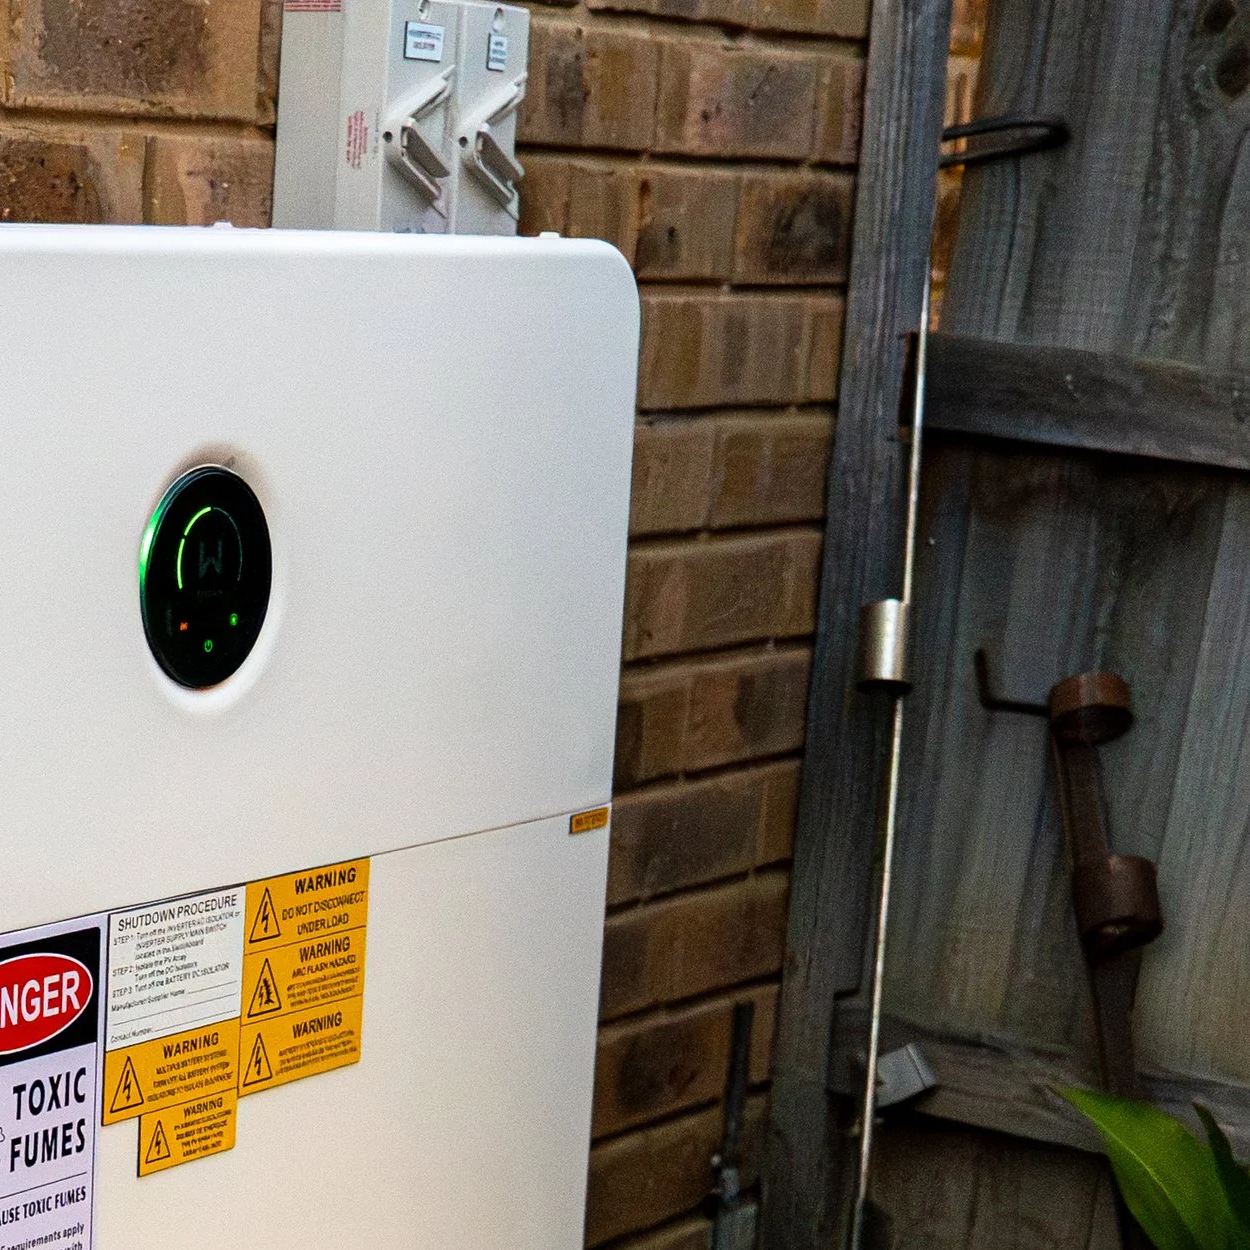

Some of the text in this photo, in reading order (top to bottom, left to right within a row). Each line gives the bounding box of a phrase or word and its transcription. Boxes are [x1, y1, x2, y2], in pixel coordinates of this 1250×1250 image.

[295, 868, 356, 895] WARNING
[118, 894, 238, 932] SHUTDOWN PROCEDURE
[282, 890, 365, 920] DO NOT DISCONNECT
[298, 913, 349, 935] UNDER LOAD
[113, 934, 130, 946] STEP
[300, 936, 350, 962] WARNING
[292, 1011, 342, 1038] WARNING
[163, 1032, 218, 1058] WARNING
[13, 1067, 86, 1120] TOXIC
[184, 1097, 222, 1118] WARNING
[10, 1118, 86, 1172] FUMES
[22, 1196, 52, 1220] TOXIC
[54, 1186, 86, 1210] FUMES
[62, 1222, 84, 1238] apply
